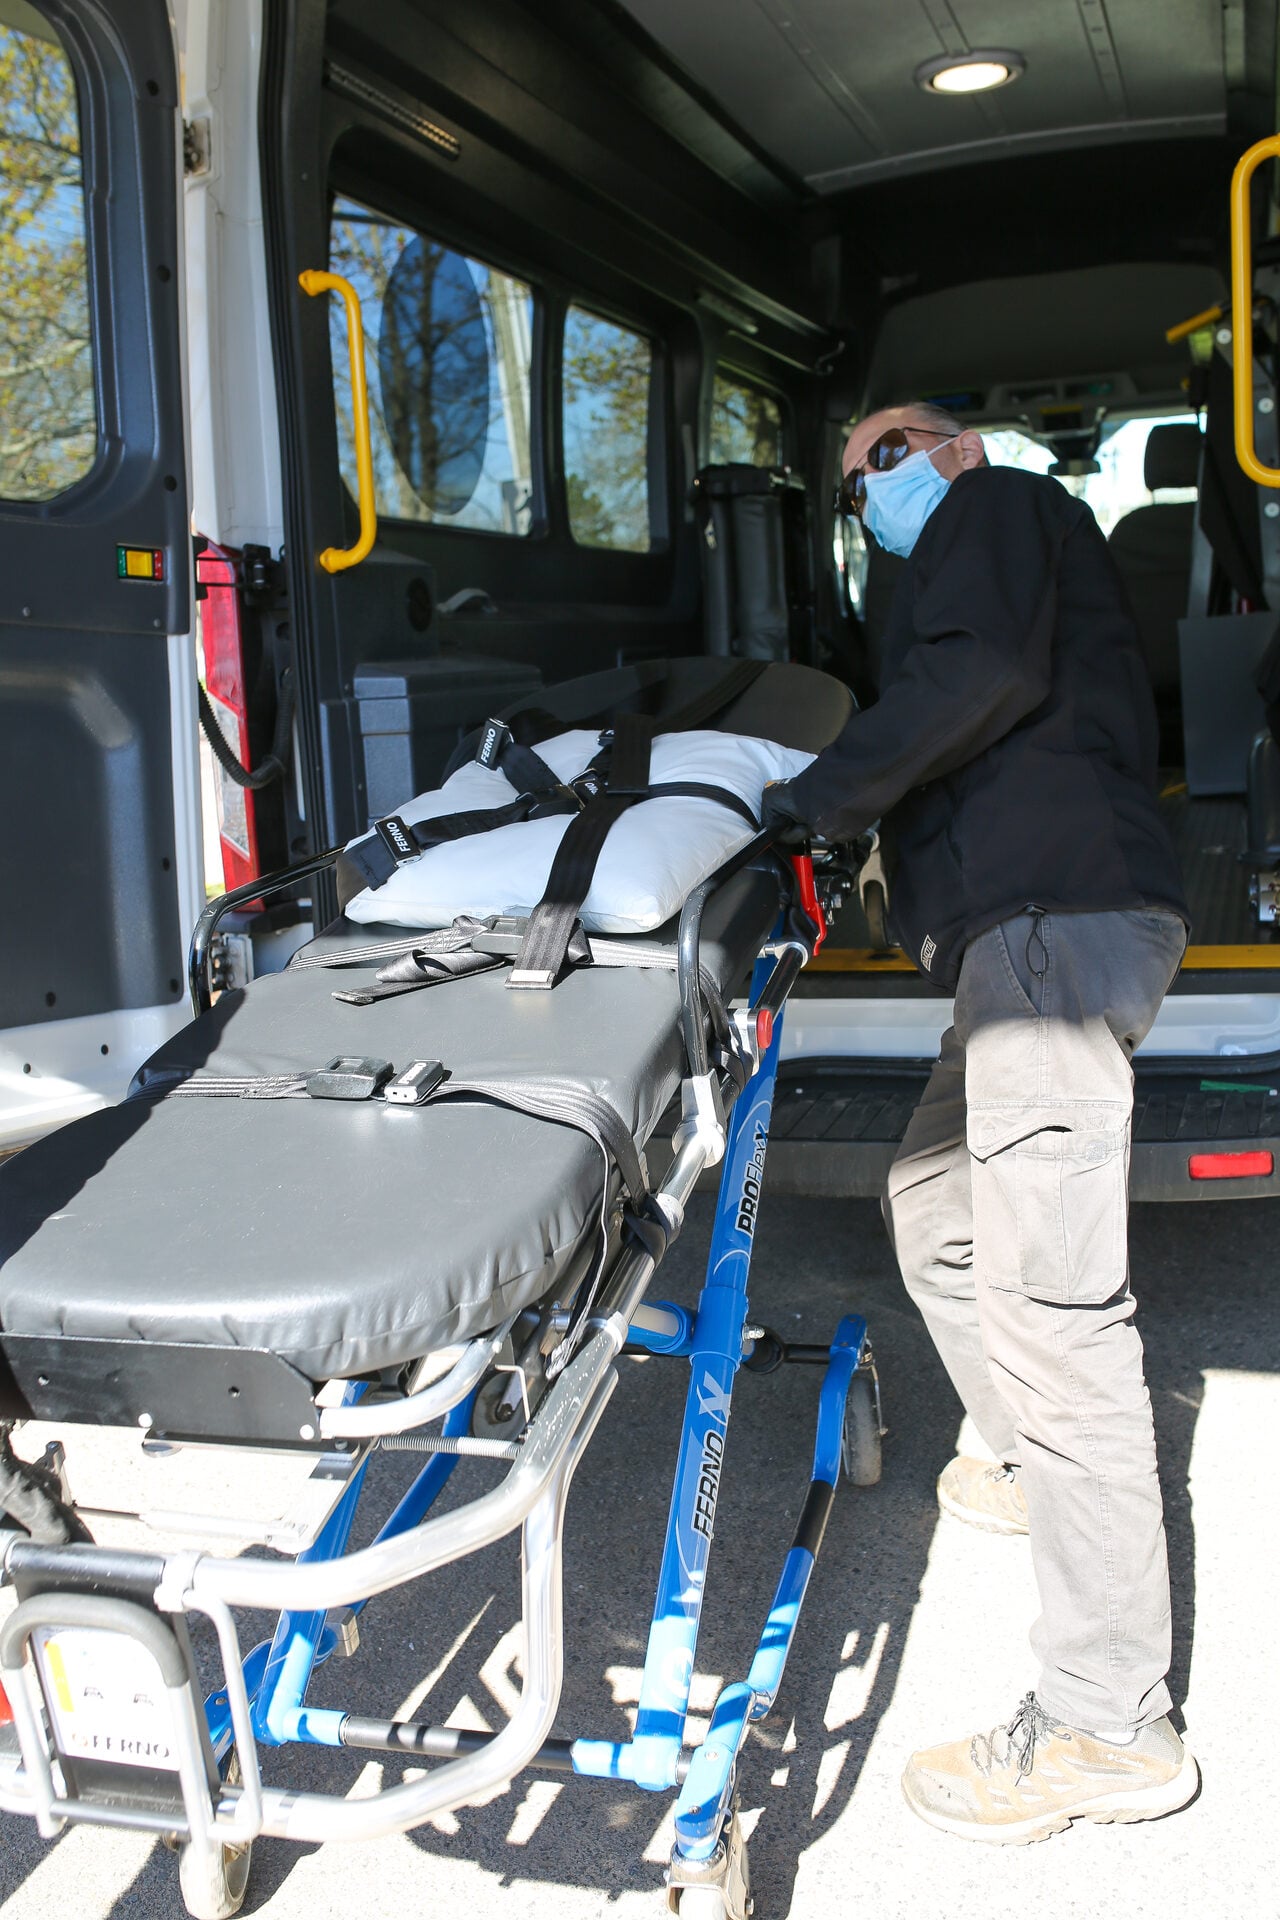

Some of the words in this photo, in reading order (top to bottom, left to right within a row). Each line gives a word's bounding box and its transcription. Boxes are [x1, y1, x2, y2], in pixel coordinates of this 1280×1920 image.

[480, 728, 496, 763] FERNO
[386, 822, 411, 852] FERNO
[737, 1120, 769, 1236] PROFlexX
[693, 1430, 724, 1540] FERNO
